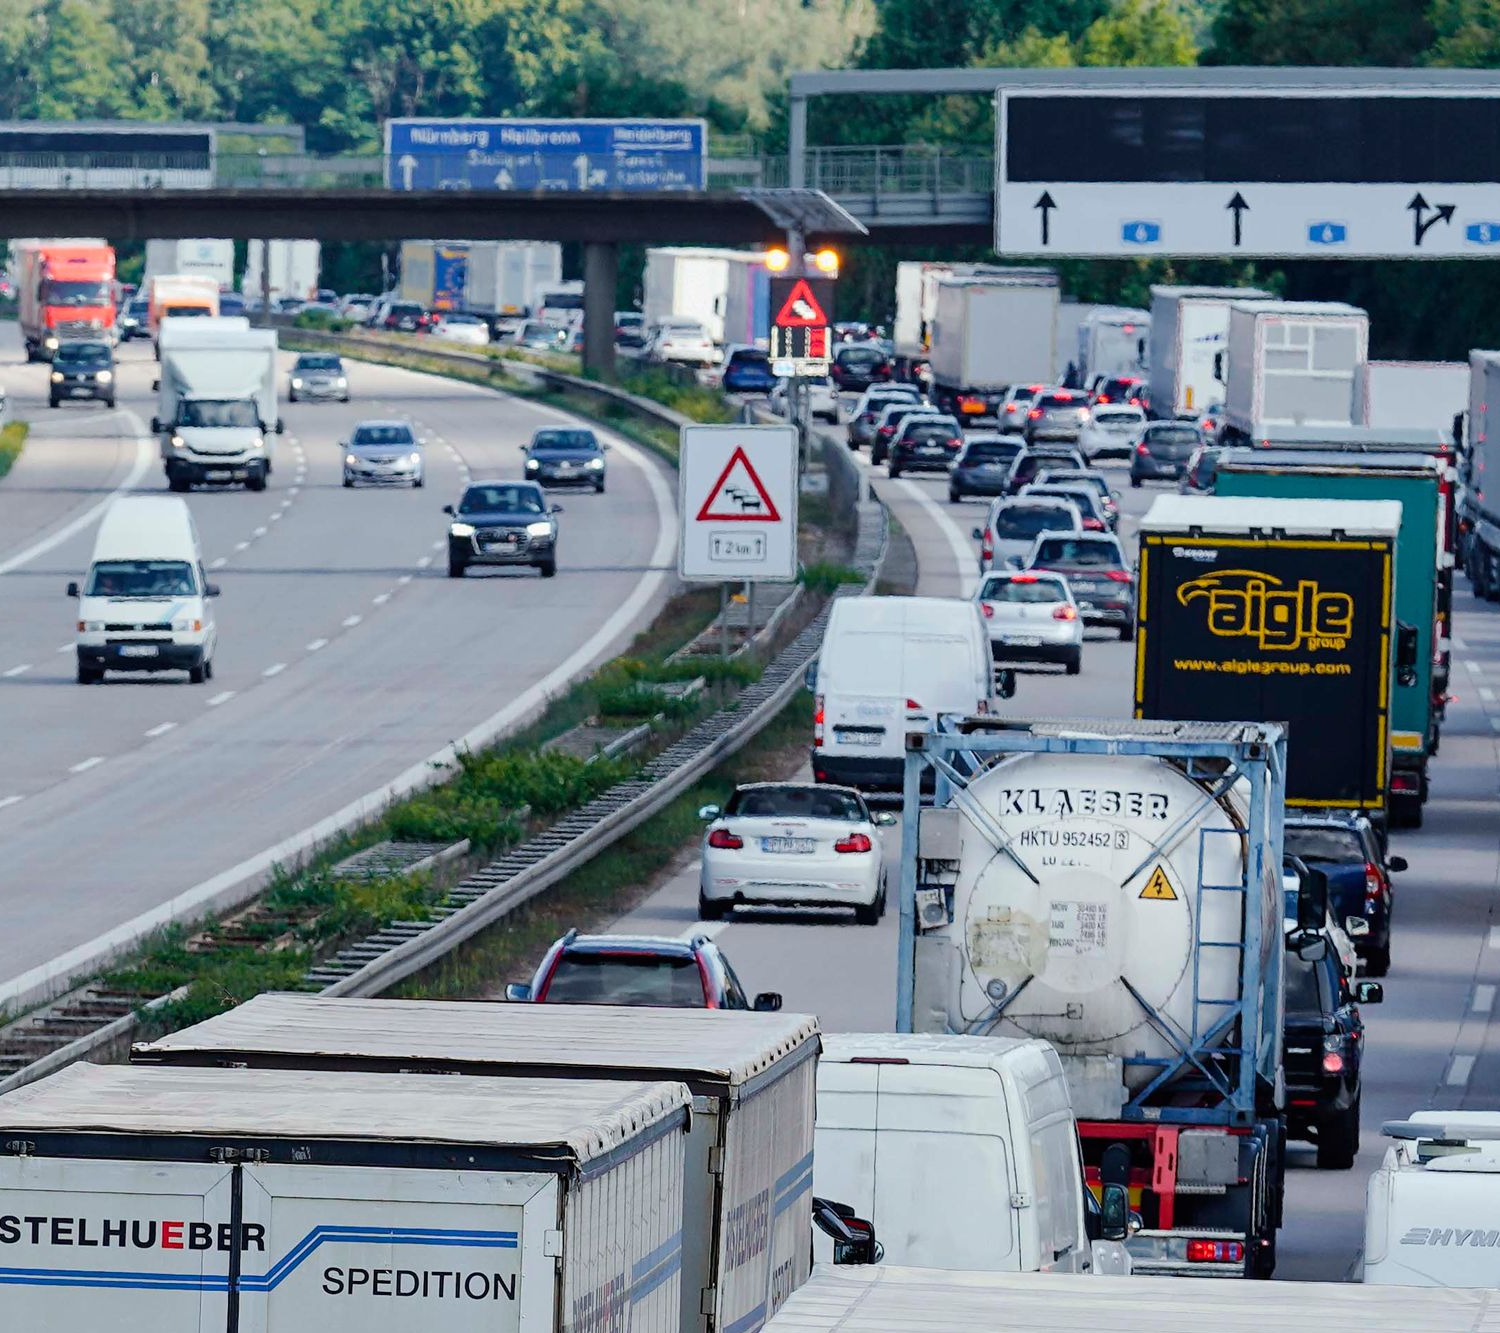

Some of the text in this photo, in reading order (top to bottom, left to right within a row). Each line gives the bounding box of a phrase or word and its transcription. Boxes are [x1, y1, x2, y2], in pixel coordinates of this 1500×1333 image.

[1208, 580, 1354, 651] aigle
[1308, 636, 1347, 651] group
[1000, 789, 1170, 821] KLAESER
[1020, 831, 1127, 849] HKTU 952452 3
[322, 1267, 517, 1301] SPEDITION
